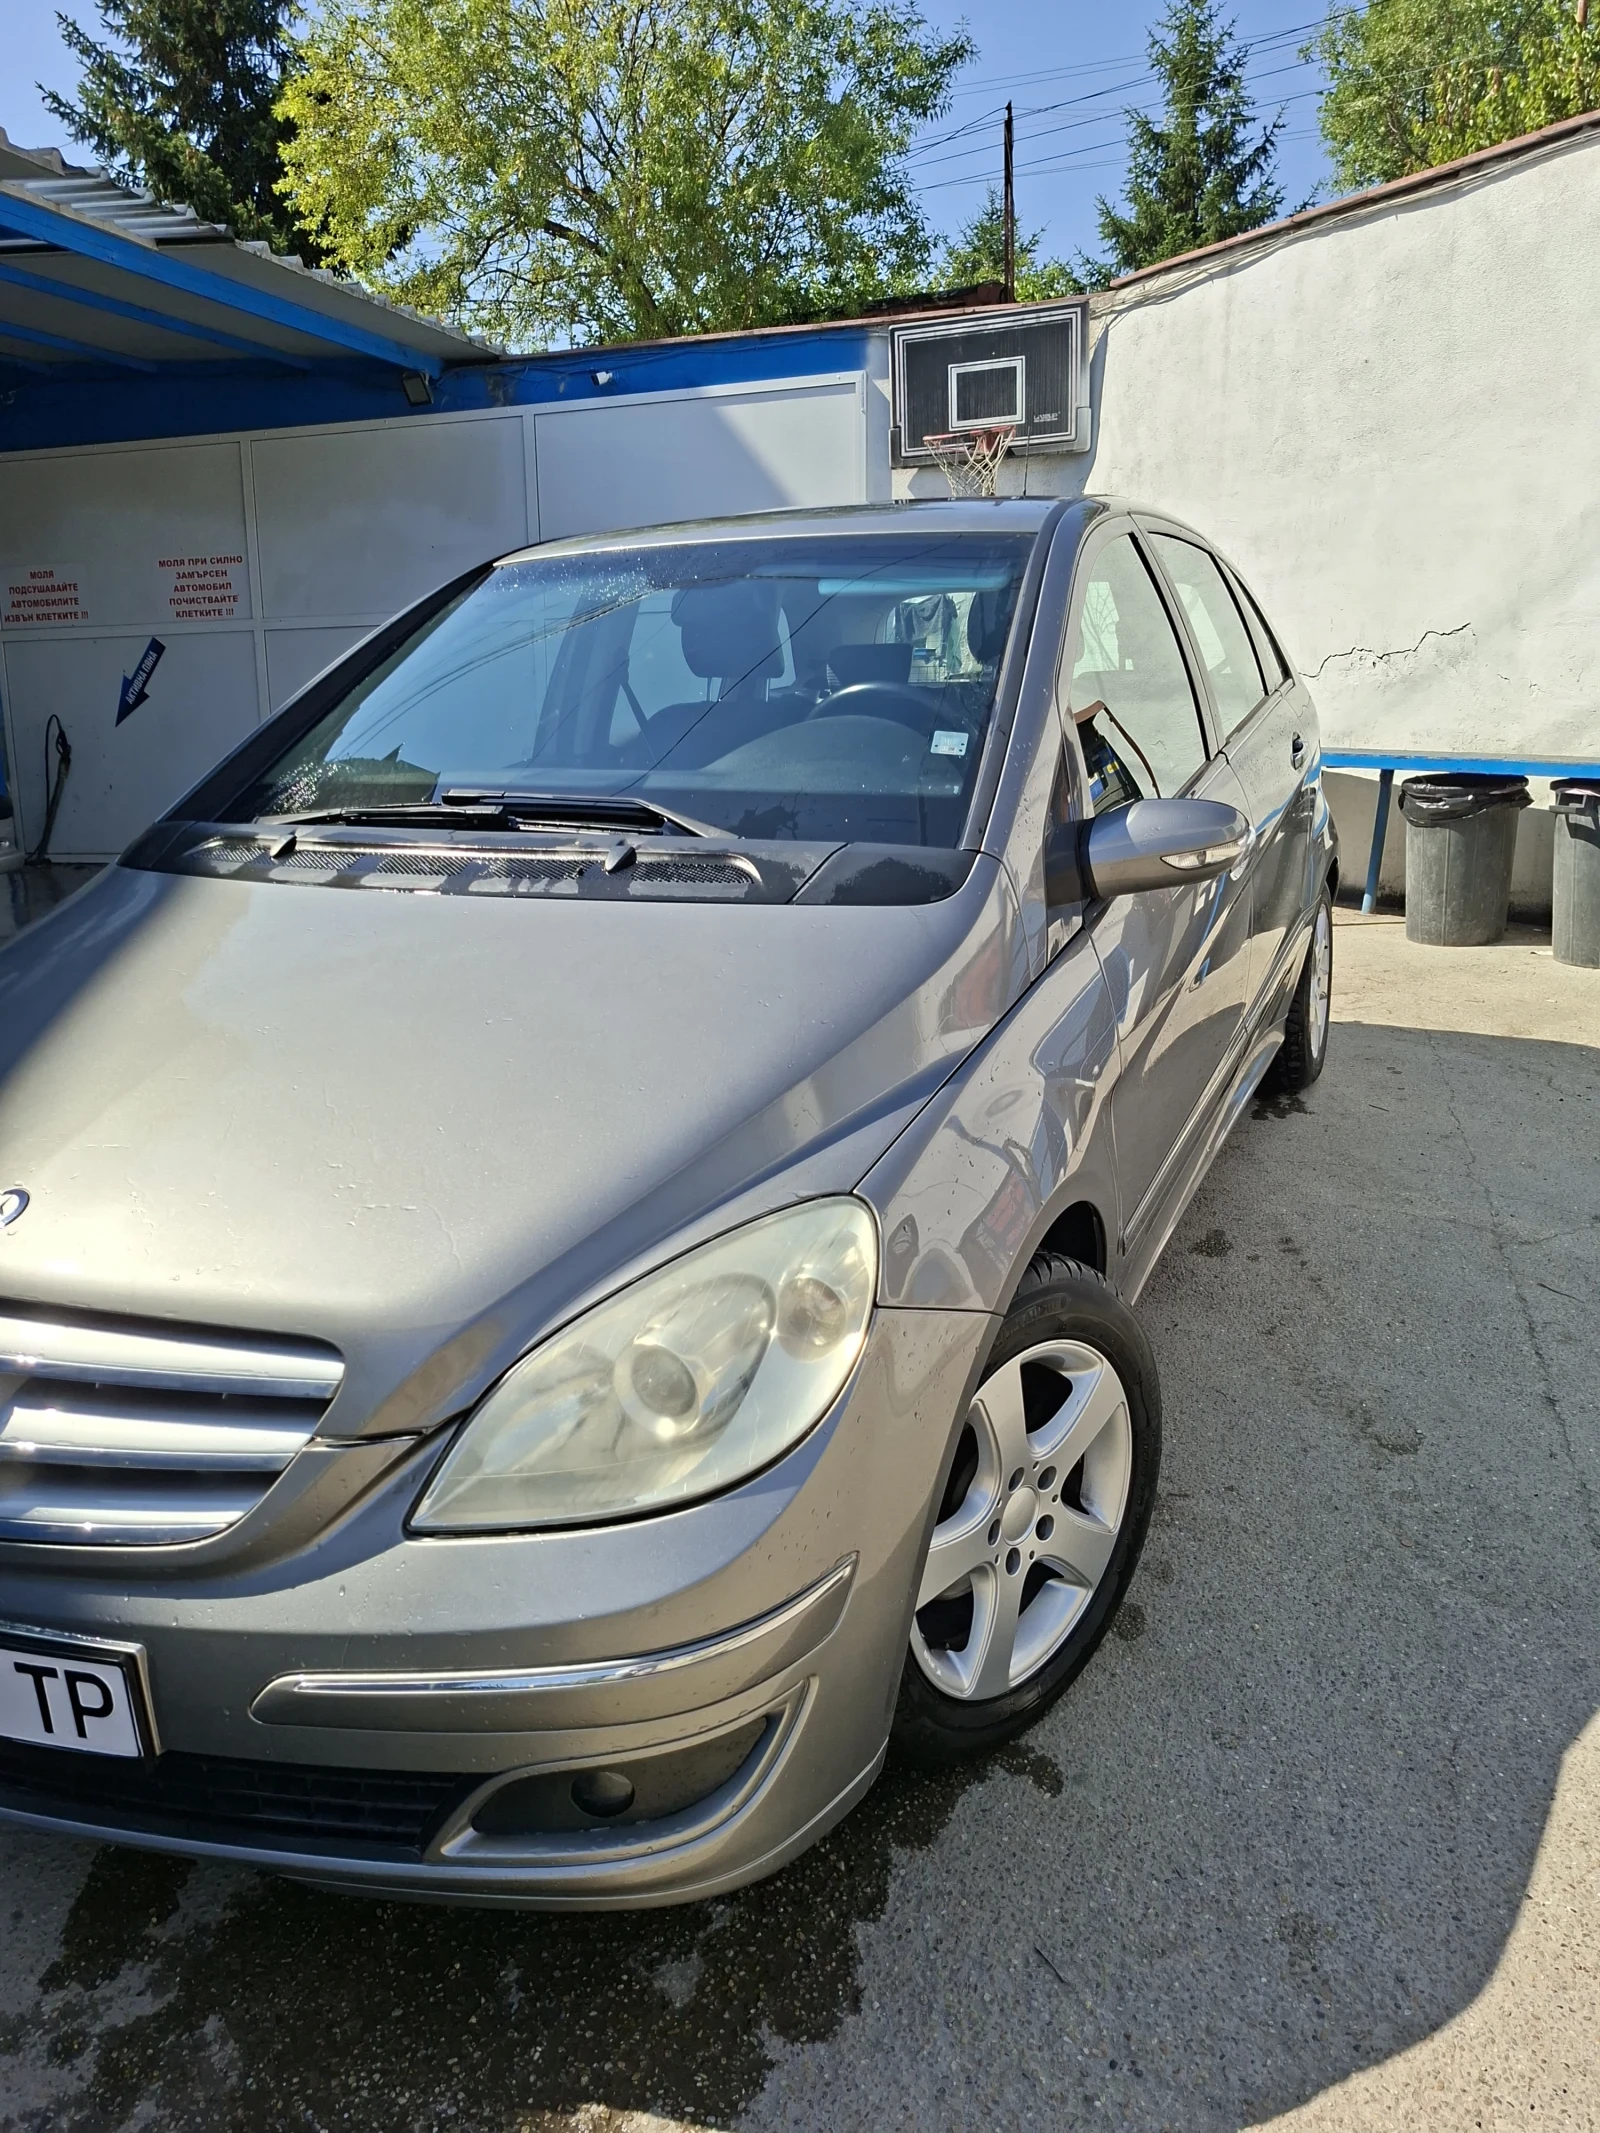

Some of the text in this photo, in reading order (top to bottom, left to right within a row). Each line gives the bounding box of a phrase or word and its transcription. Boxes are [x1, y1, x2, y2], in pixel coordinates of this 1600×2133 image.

[158, 555, 243, 568] МОЛЯ ПРИ СИЛНО
[29, 570, 55, 580] МОЛЯ
[175, 569, 228, 580] ЗАМЪРСЕН
[8, 582, 79, 595] ПОДСУШАВАЙТЕ
[173, 582, 232, 593] АВТОМОБИЛ
[11, 597, 80, 608] АВТОМОБИЛИТЕ
[169, 594, 239, 606] ПОЧИСТВАЙТЕ
[4, 611, 89, 623] ИЗВЪН КЛЕТКИТЕ !!!
[175, 608, 234, 618] КЛЕТКИТЕ !!!
[125, 650, 158, 705] АКТИВНА ПЯНА
[13, 1661, 114, 1739] TP
